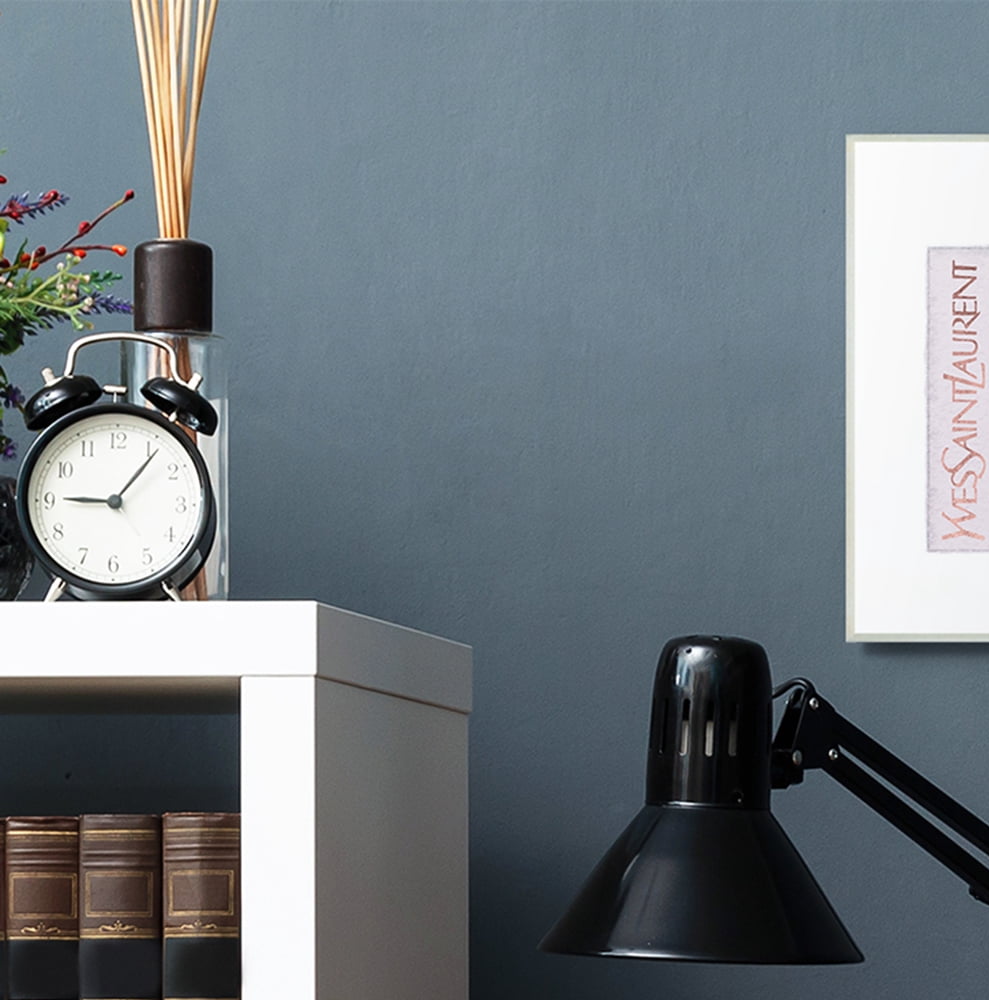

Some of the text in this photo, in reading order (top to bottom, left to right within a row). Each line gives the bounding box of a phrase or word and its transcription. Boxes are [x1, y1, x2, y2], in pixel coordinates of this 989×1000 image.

[80, 440, 94, 457] 11
[109, 432, 127, 450] 12
[146, 440, 152, 457] 1
[58, 462, 73, 479] 10
[167, 463, 179, 480] 2
[44, 492, 56, 510] 9
[175, 496, 187, 514] 3
[52, 523, 64, 541] 8
[164, 526, 176, 542] 4
[78, 547, 89, 565] 7
[108, 555, 119, 573] 6
[142, 547, 153, 565] 5
